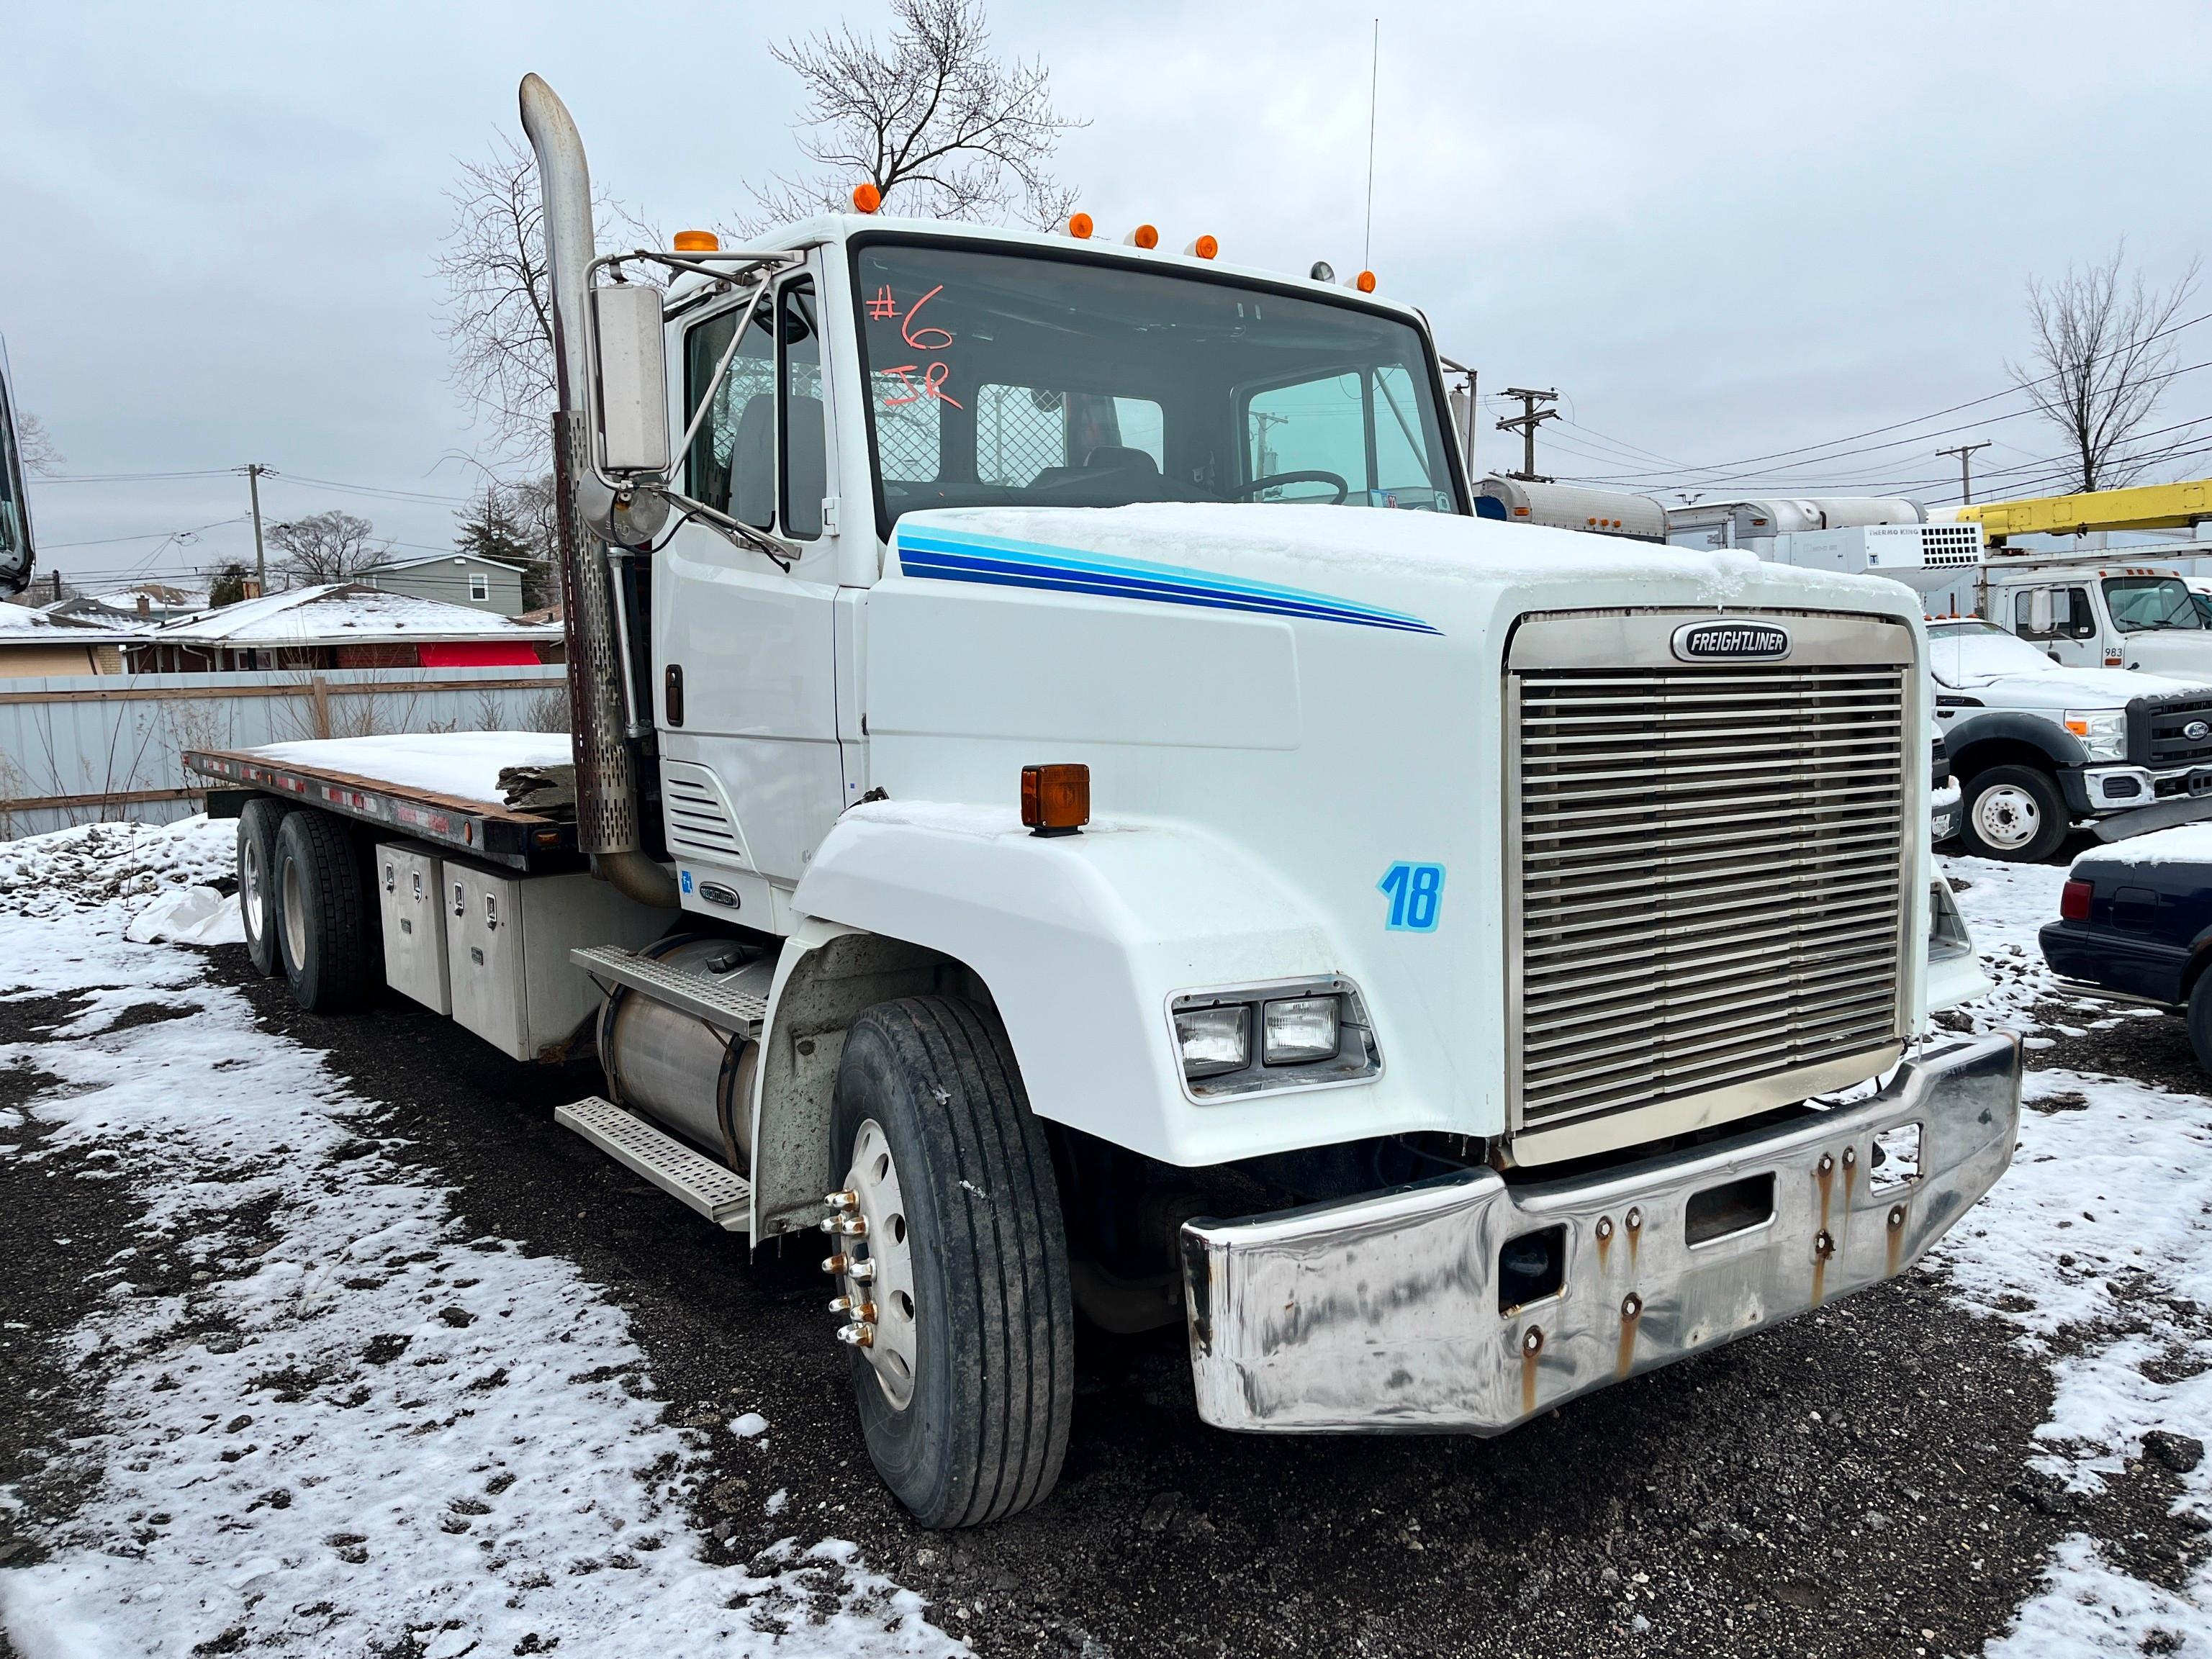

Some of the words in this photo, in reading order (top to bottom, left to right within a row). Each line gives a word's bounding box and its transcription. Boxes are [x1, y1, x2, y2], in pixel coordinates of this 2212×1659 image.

[1691, 631, 1784, 651] FREIGHTLINER
[2105, 648, 2123, 657] 983
[1381, 866, 1440, 928] 18
